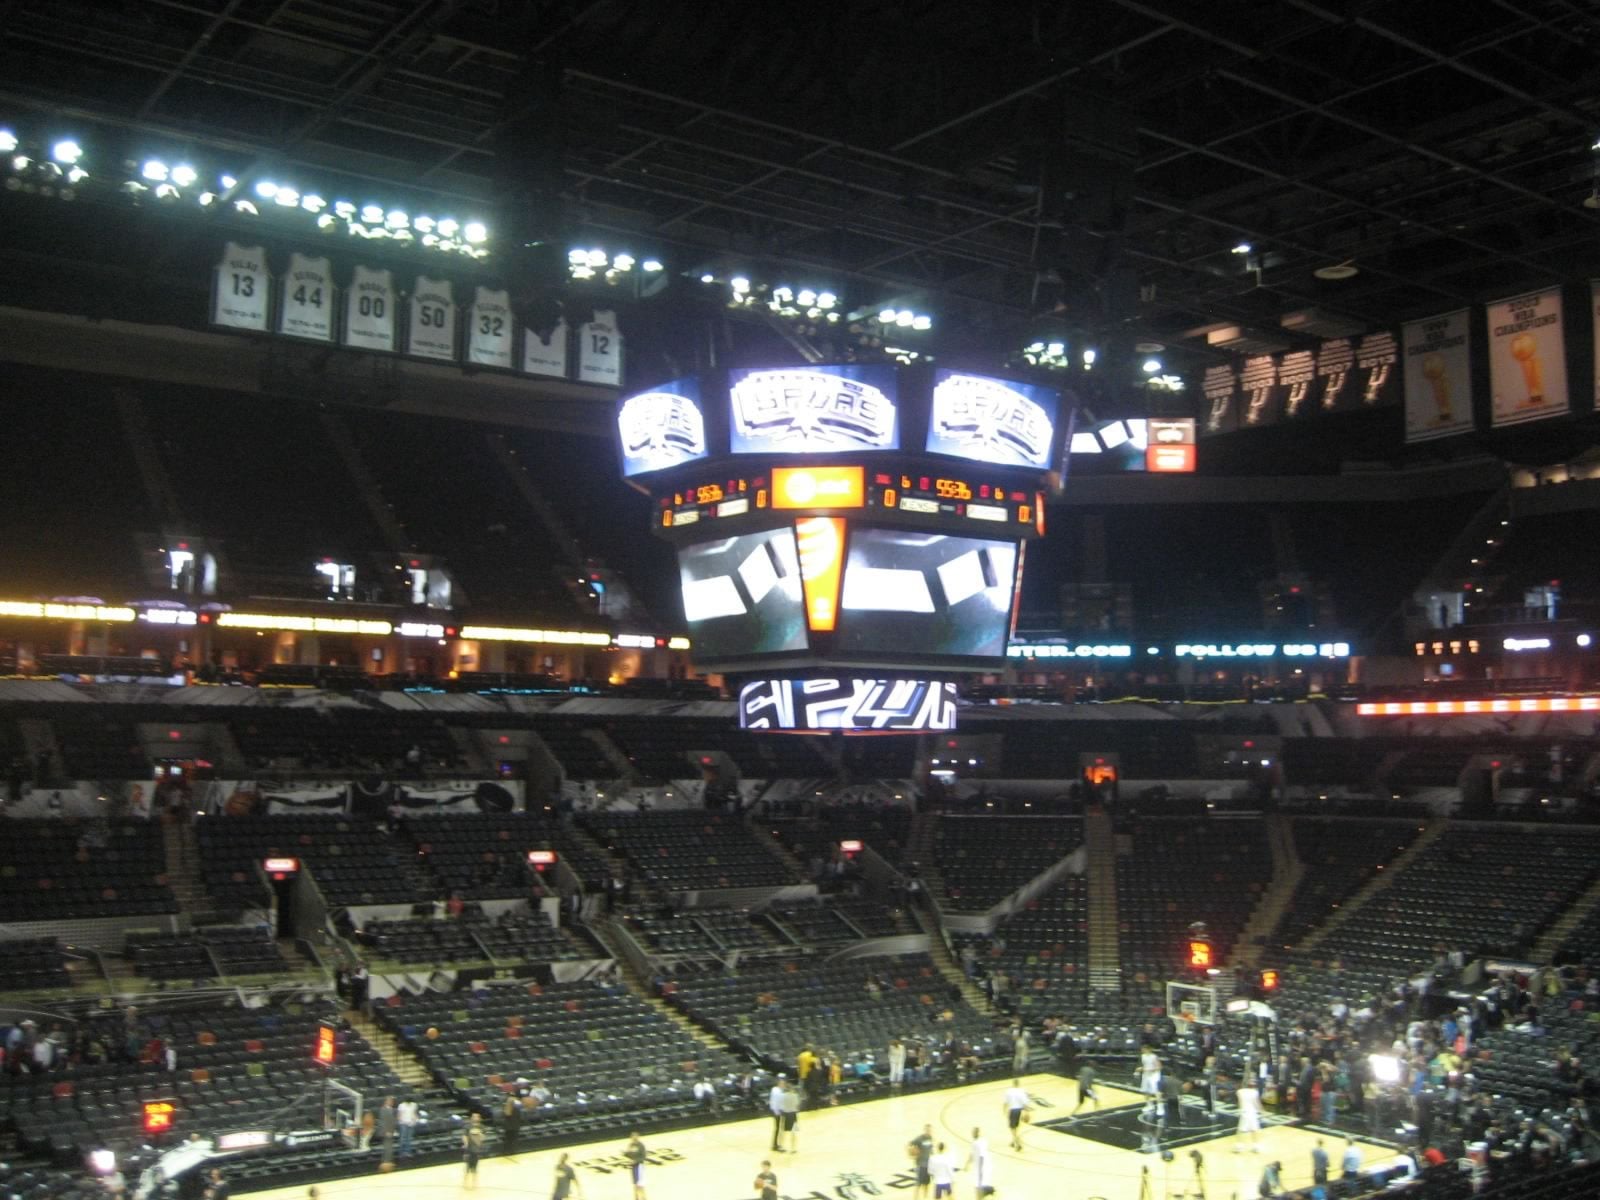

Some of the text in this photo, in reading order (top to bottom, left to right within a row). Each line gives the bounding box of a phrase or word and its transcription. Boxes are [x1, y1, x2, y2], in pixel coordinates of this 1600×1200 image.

[232, 273, 254, 297] 13
[293, 285, 323, 308] 44
[360, 295, 384, 318] 00
[421, 305, 445, 328] 50
[480, 315, 504, 337] 32
[591, 334, 609, 355] 12
[1175, 644, 1317, 656] FOLLOW US
